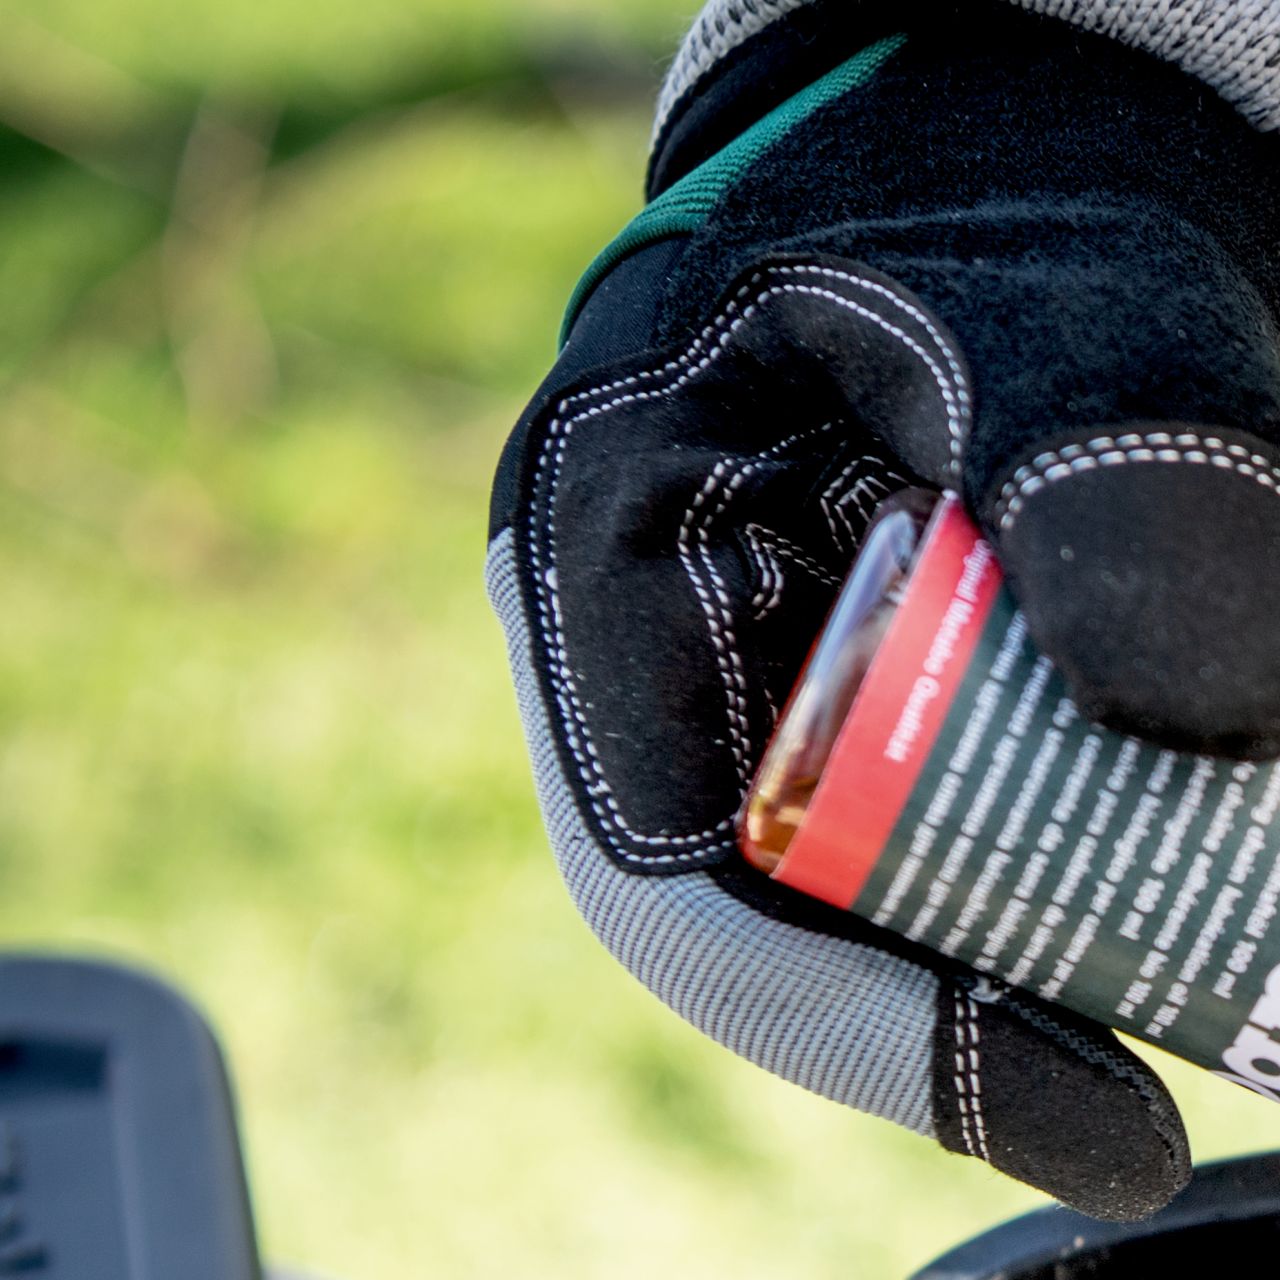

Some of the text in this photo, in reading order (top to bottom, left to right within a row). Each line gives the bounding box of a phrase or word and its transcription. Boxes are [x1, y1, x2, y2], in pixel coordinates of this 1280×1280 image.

[1036, 821, 1064, 852] de
[1227, 824, 1266, 884] chain
[1132, 877, 1165, 913] 100
[1117, 909, 1144, 940] ml
[1177, 883, 1243, 983] lubrication
[1137, 949, 1169, 979] bio
[1225, 939, 1257, 973] 100
[1165, 981, 1188, 1006] oil
[1211, 970, 1236, 999] ml
